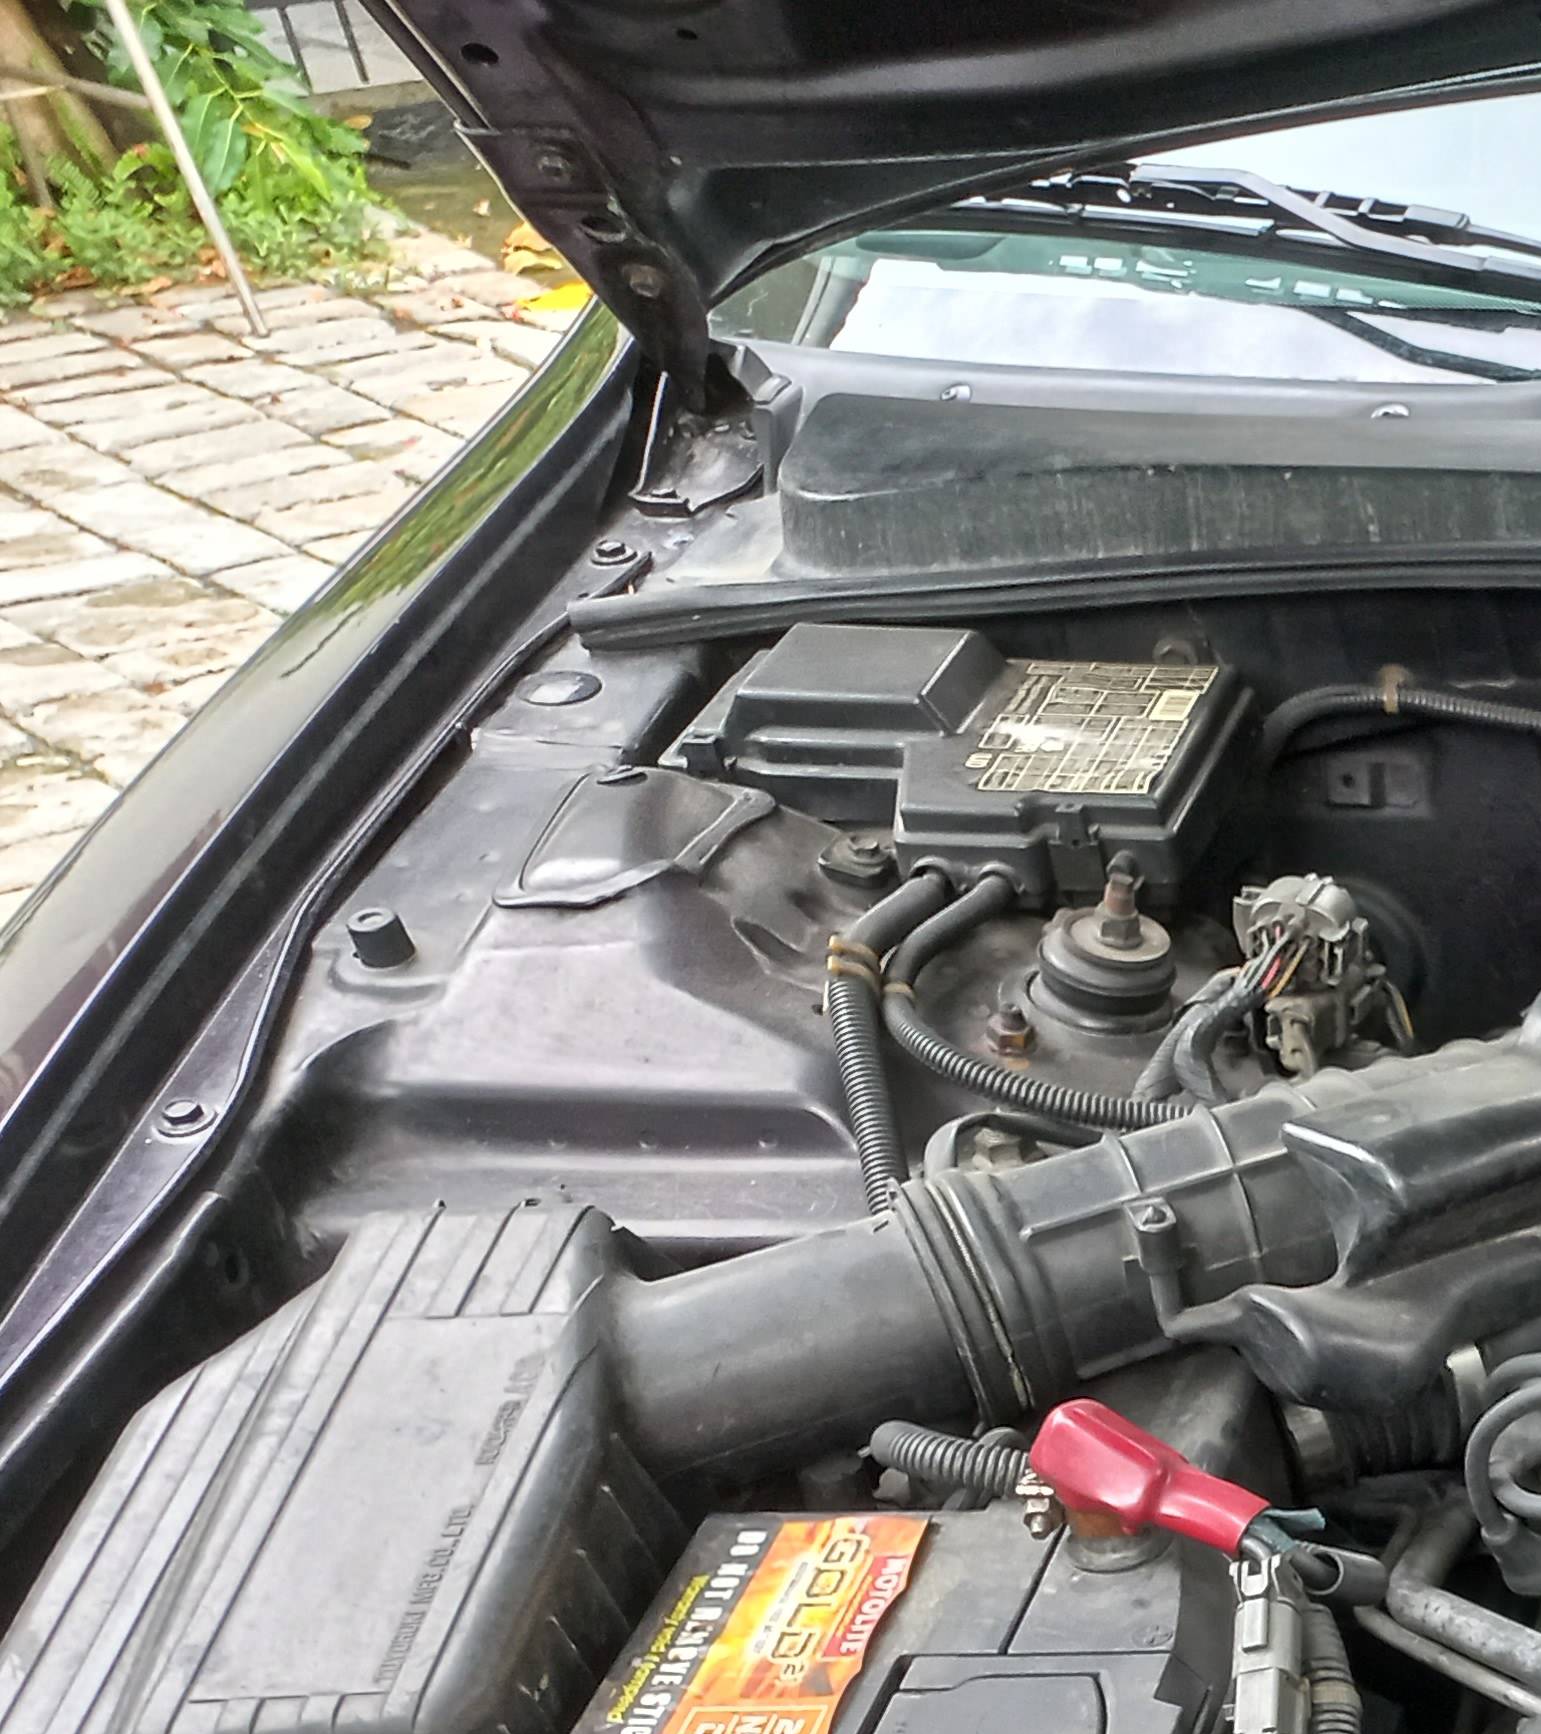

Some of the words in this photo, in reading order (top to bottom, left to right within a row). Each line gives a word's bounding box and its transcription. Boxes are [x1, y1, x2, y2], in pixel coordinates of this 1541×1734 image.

[730, 1531, 767, 1556] DO
[704, 1563, 748, 1600] NOT
[771, 1538, 864, 1658] GOLD
[839, 1558, 907, 1654] MOTOLITE
